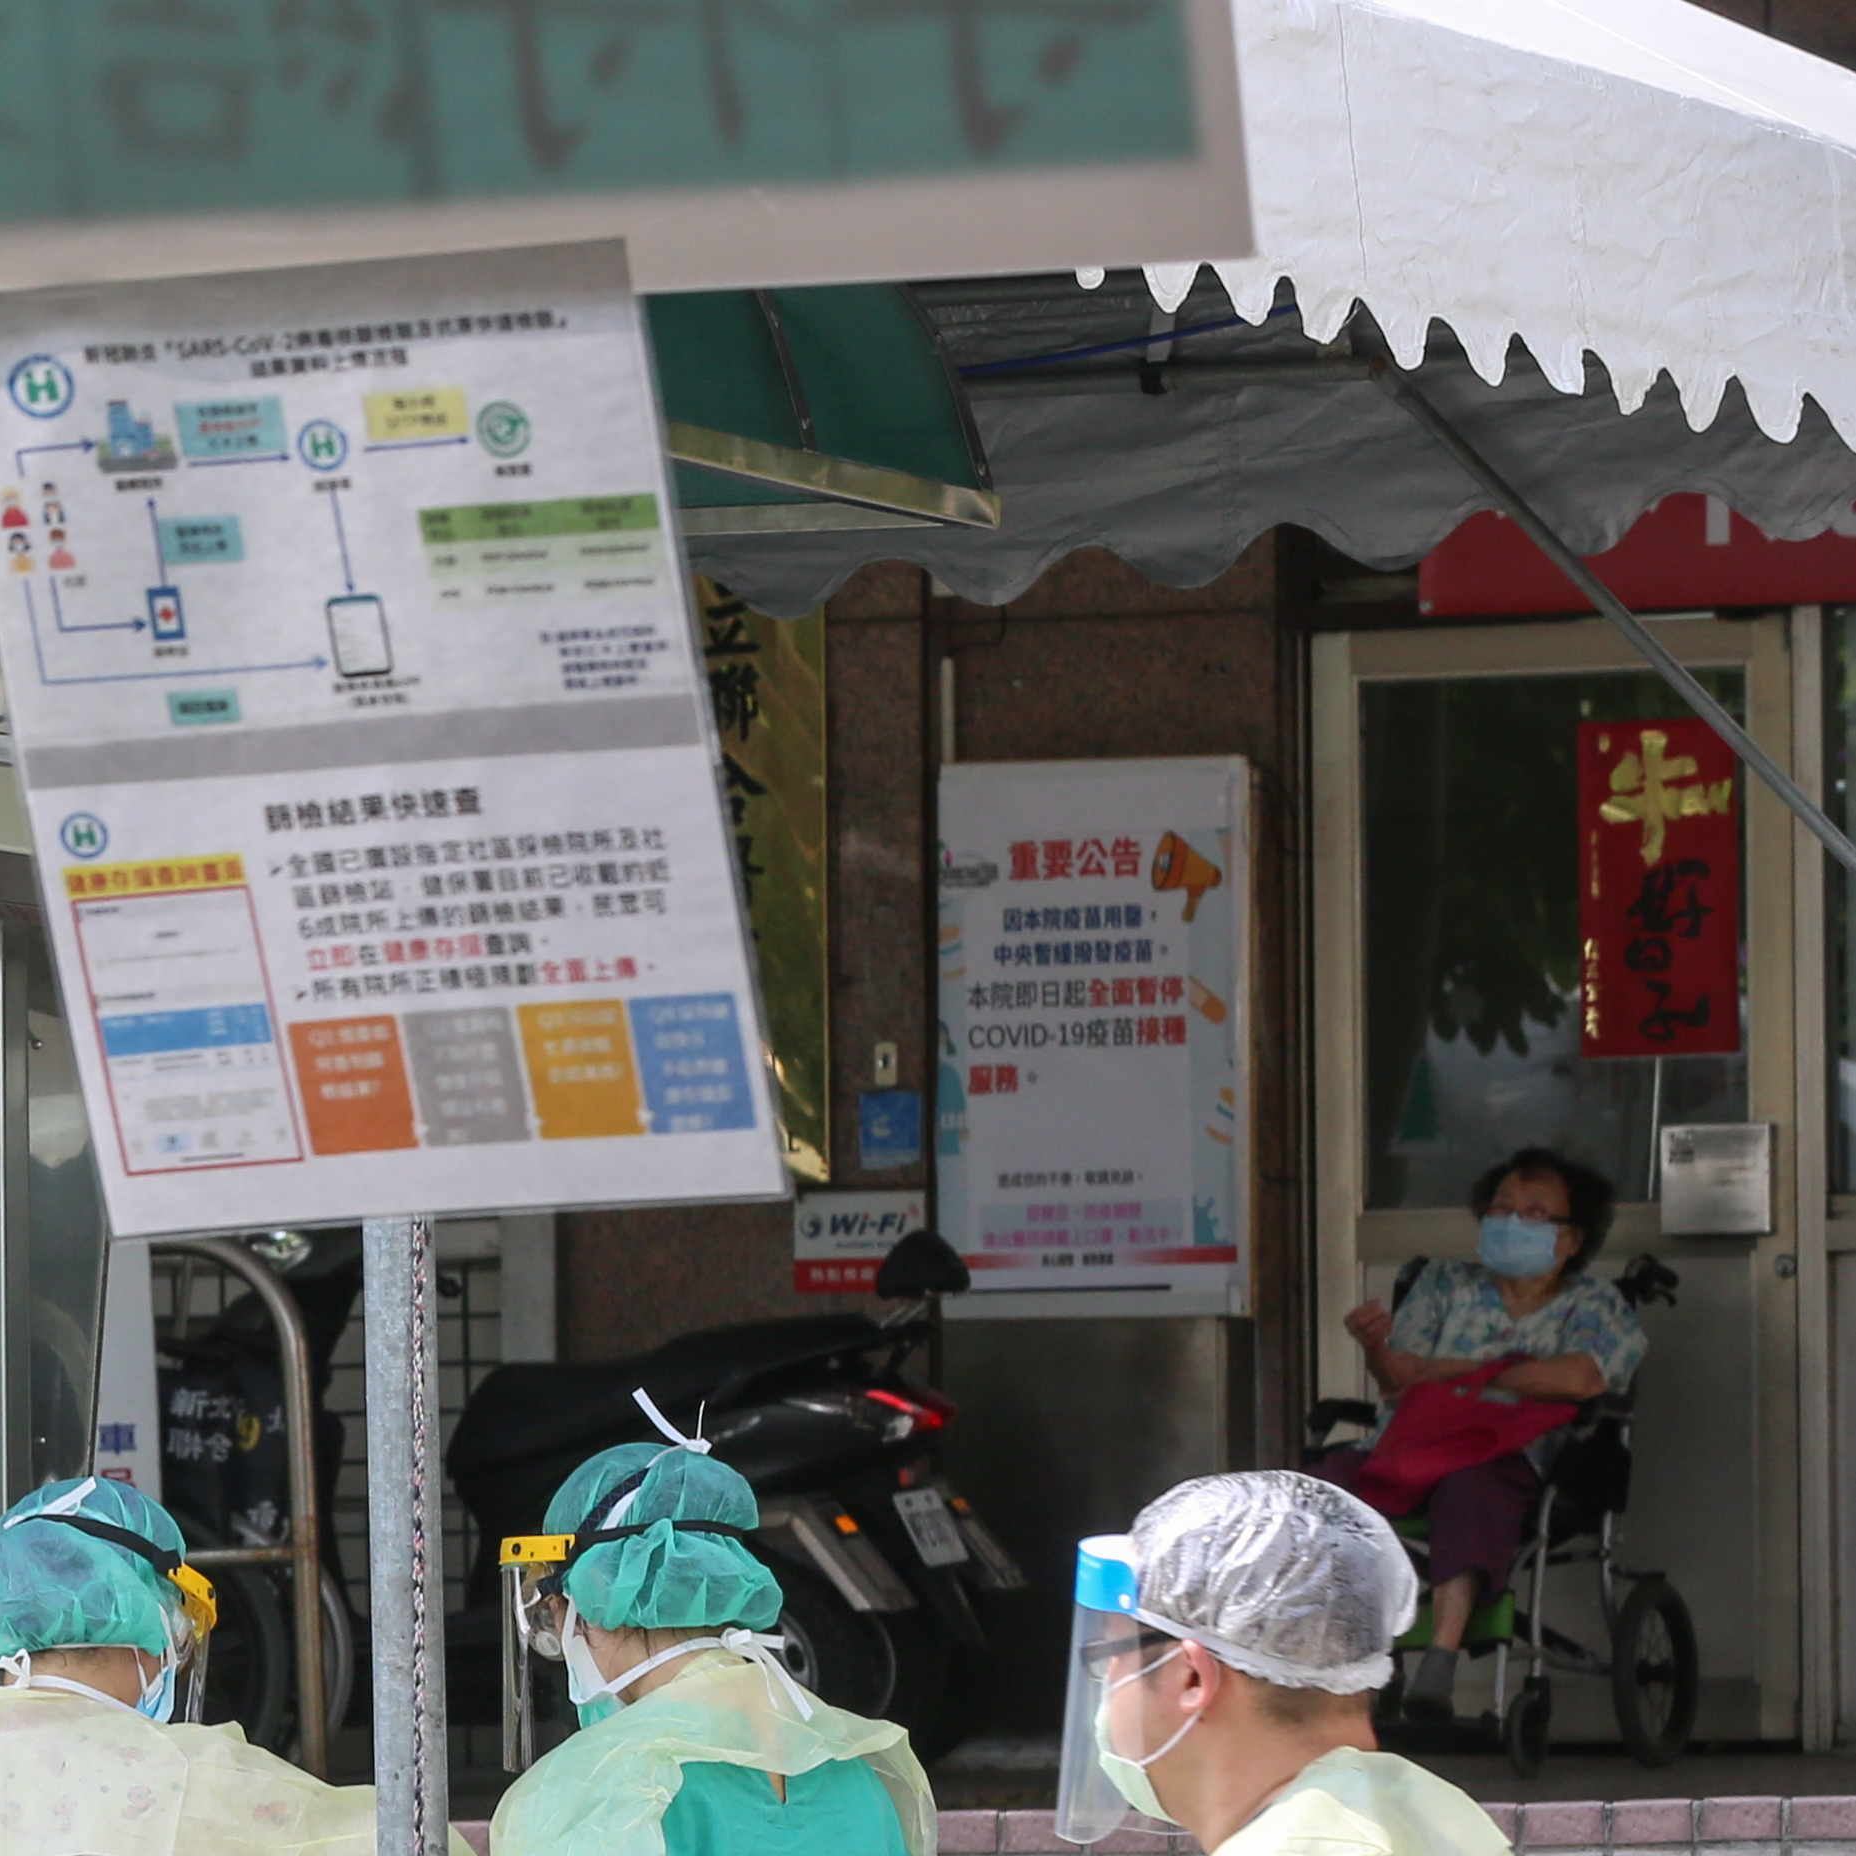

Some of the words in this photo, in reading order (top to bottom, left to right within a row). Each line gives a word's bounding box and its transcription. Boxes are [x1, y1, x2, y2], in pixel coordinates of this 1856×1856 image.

[263, 786, 482, 833] 篩檢結果快速查
[1008, 836, 1141, 881] 重要公告
[967, 976, 1185, 1008] 本院即日起全面暫停
[967, 1015, 1187, 1049] COVID-19疫苗接種
[967, 1063, 1038, 1095] 服務。
[829, 1211, 908, 1236] Wi-Fi
